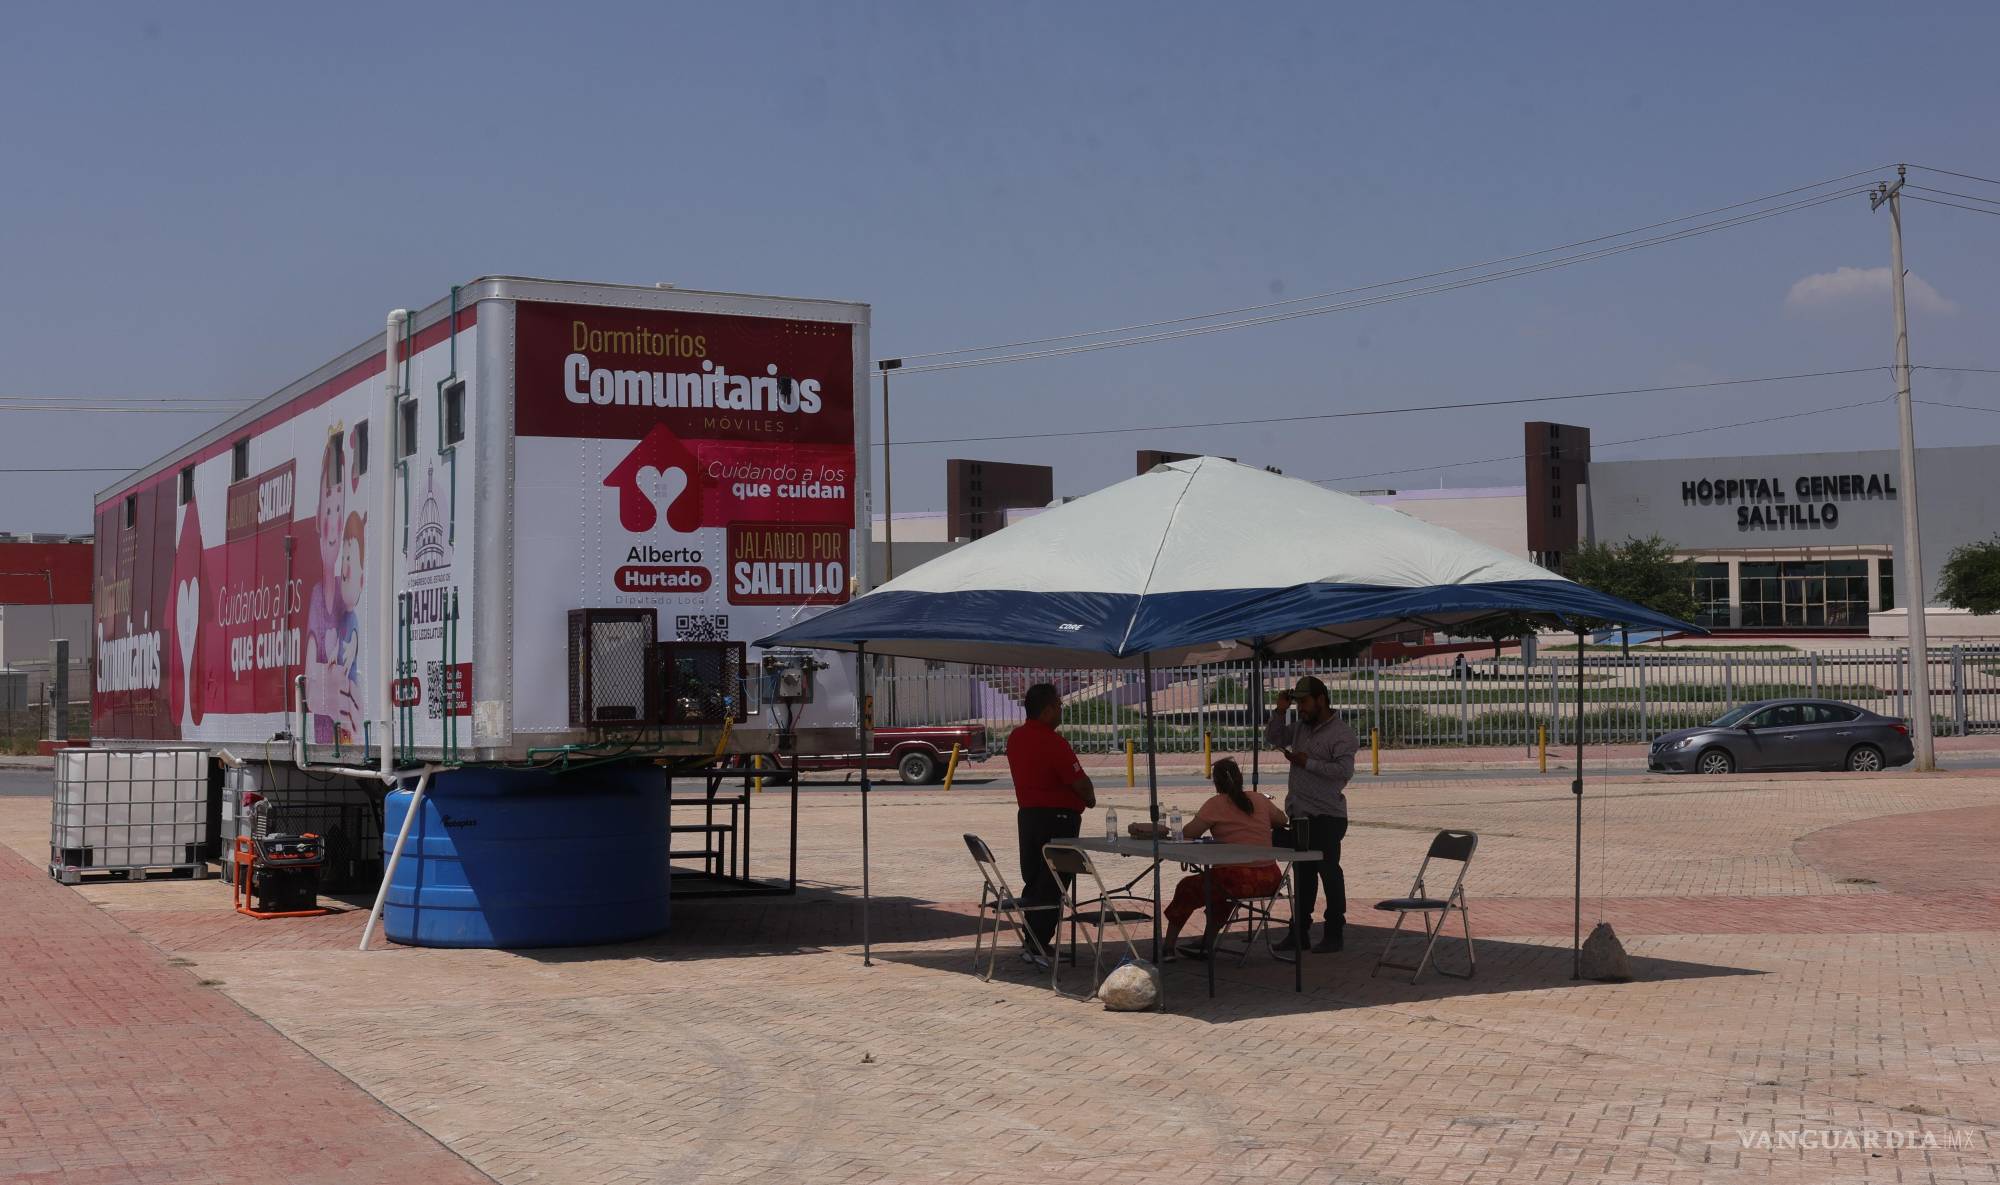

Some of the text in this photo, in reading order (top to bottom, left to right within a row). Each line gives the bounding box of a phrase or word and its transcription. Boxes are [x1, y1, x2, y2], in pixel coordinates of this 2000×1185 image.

[572, 320, 706, 358] Dormitorios
[564, 353, 822, 414] Comunitarios
[704, 415, 785, 433] MÓVILES
[708, 461, 846, 482] Cuidando a los
[257, 472, 292, 524] SALTILLO
[732, 481, 846, 500] que cuidan
[1795, 474, 1897, 500] GENERAL
[1737, 503, 1839, 530] SALTILLO
[626, 546, 702, 563] Alberto
[735, 532, 842, 560] JALANDO POR
[625, 571, 702, 587] Hurtado
[734, 562, 844, 595] SALTILLO
[218, 575, 270, 627] Cuidando
[272, 584, 281, 618] a
[97, 611, 161, 692] Comunitarios
[231, 634, 253, 680] que
